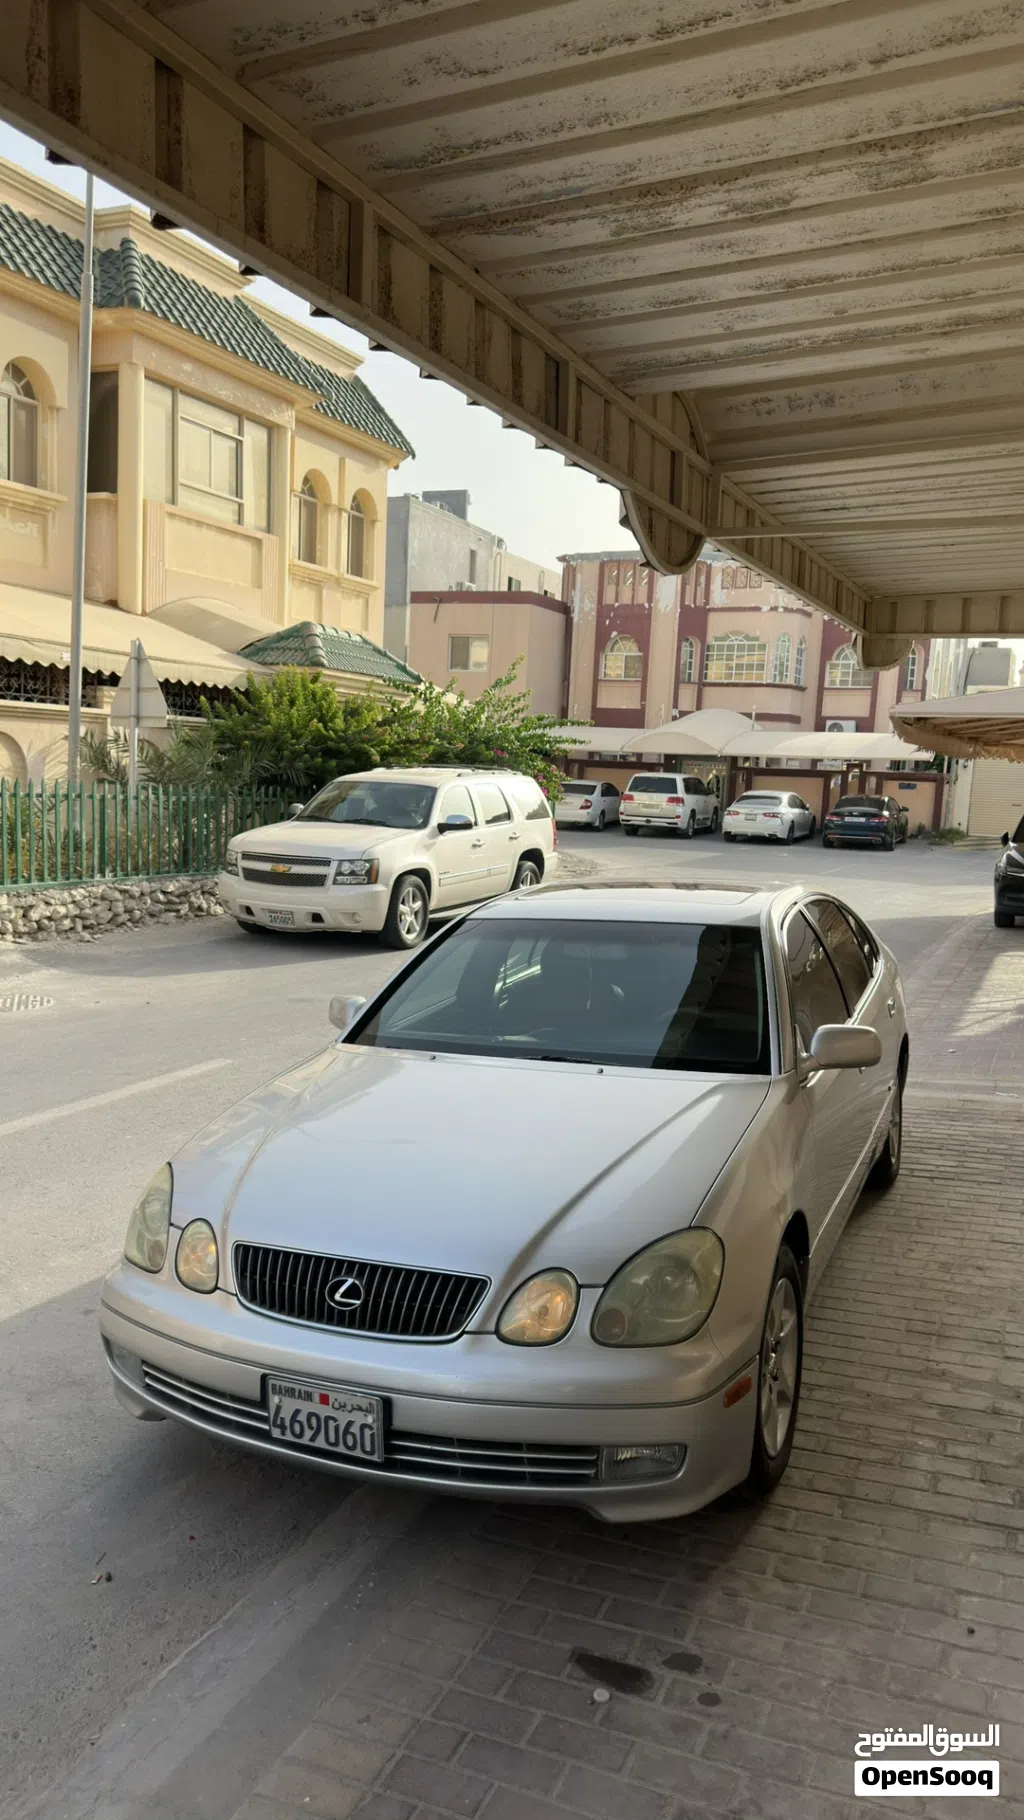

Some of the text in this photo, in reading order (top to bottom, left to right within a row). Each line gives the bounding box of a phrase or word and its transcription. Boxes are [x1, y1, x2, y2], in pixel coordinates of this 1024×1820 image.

[271, 1383, 313, 1403] BAHRAIN
[331, 1397, 375, 1417] البحرين
[272, 1404, 376, 1456] 469060
